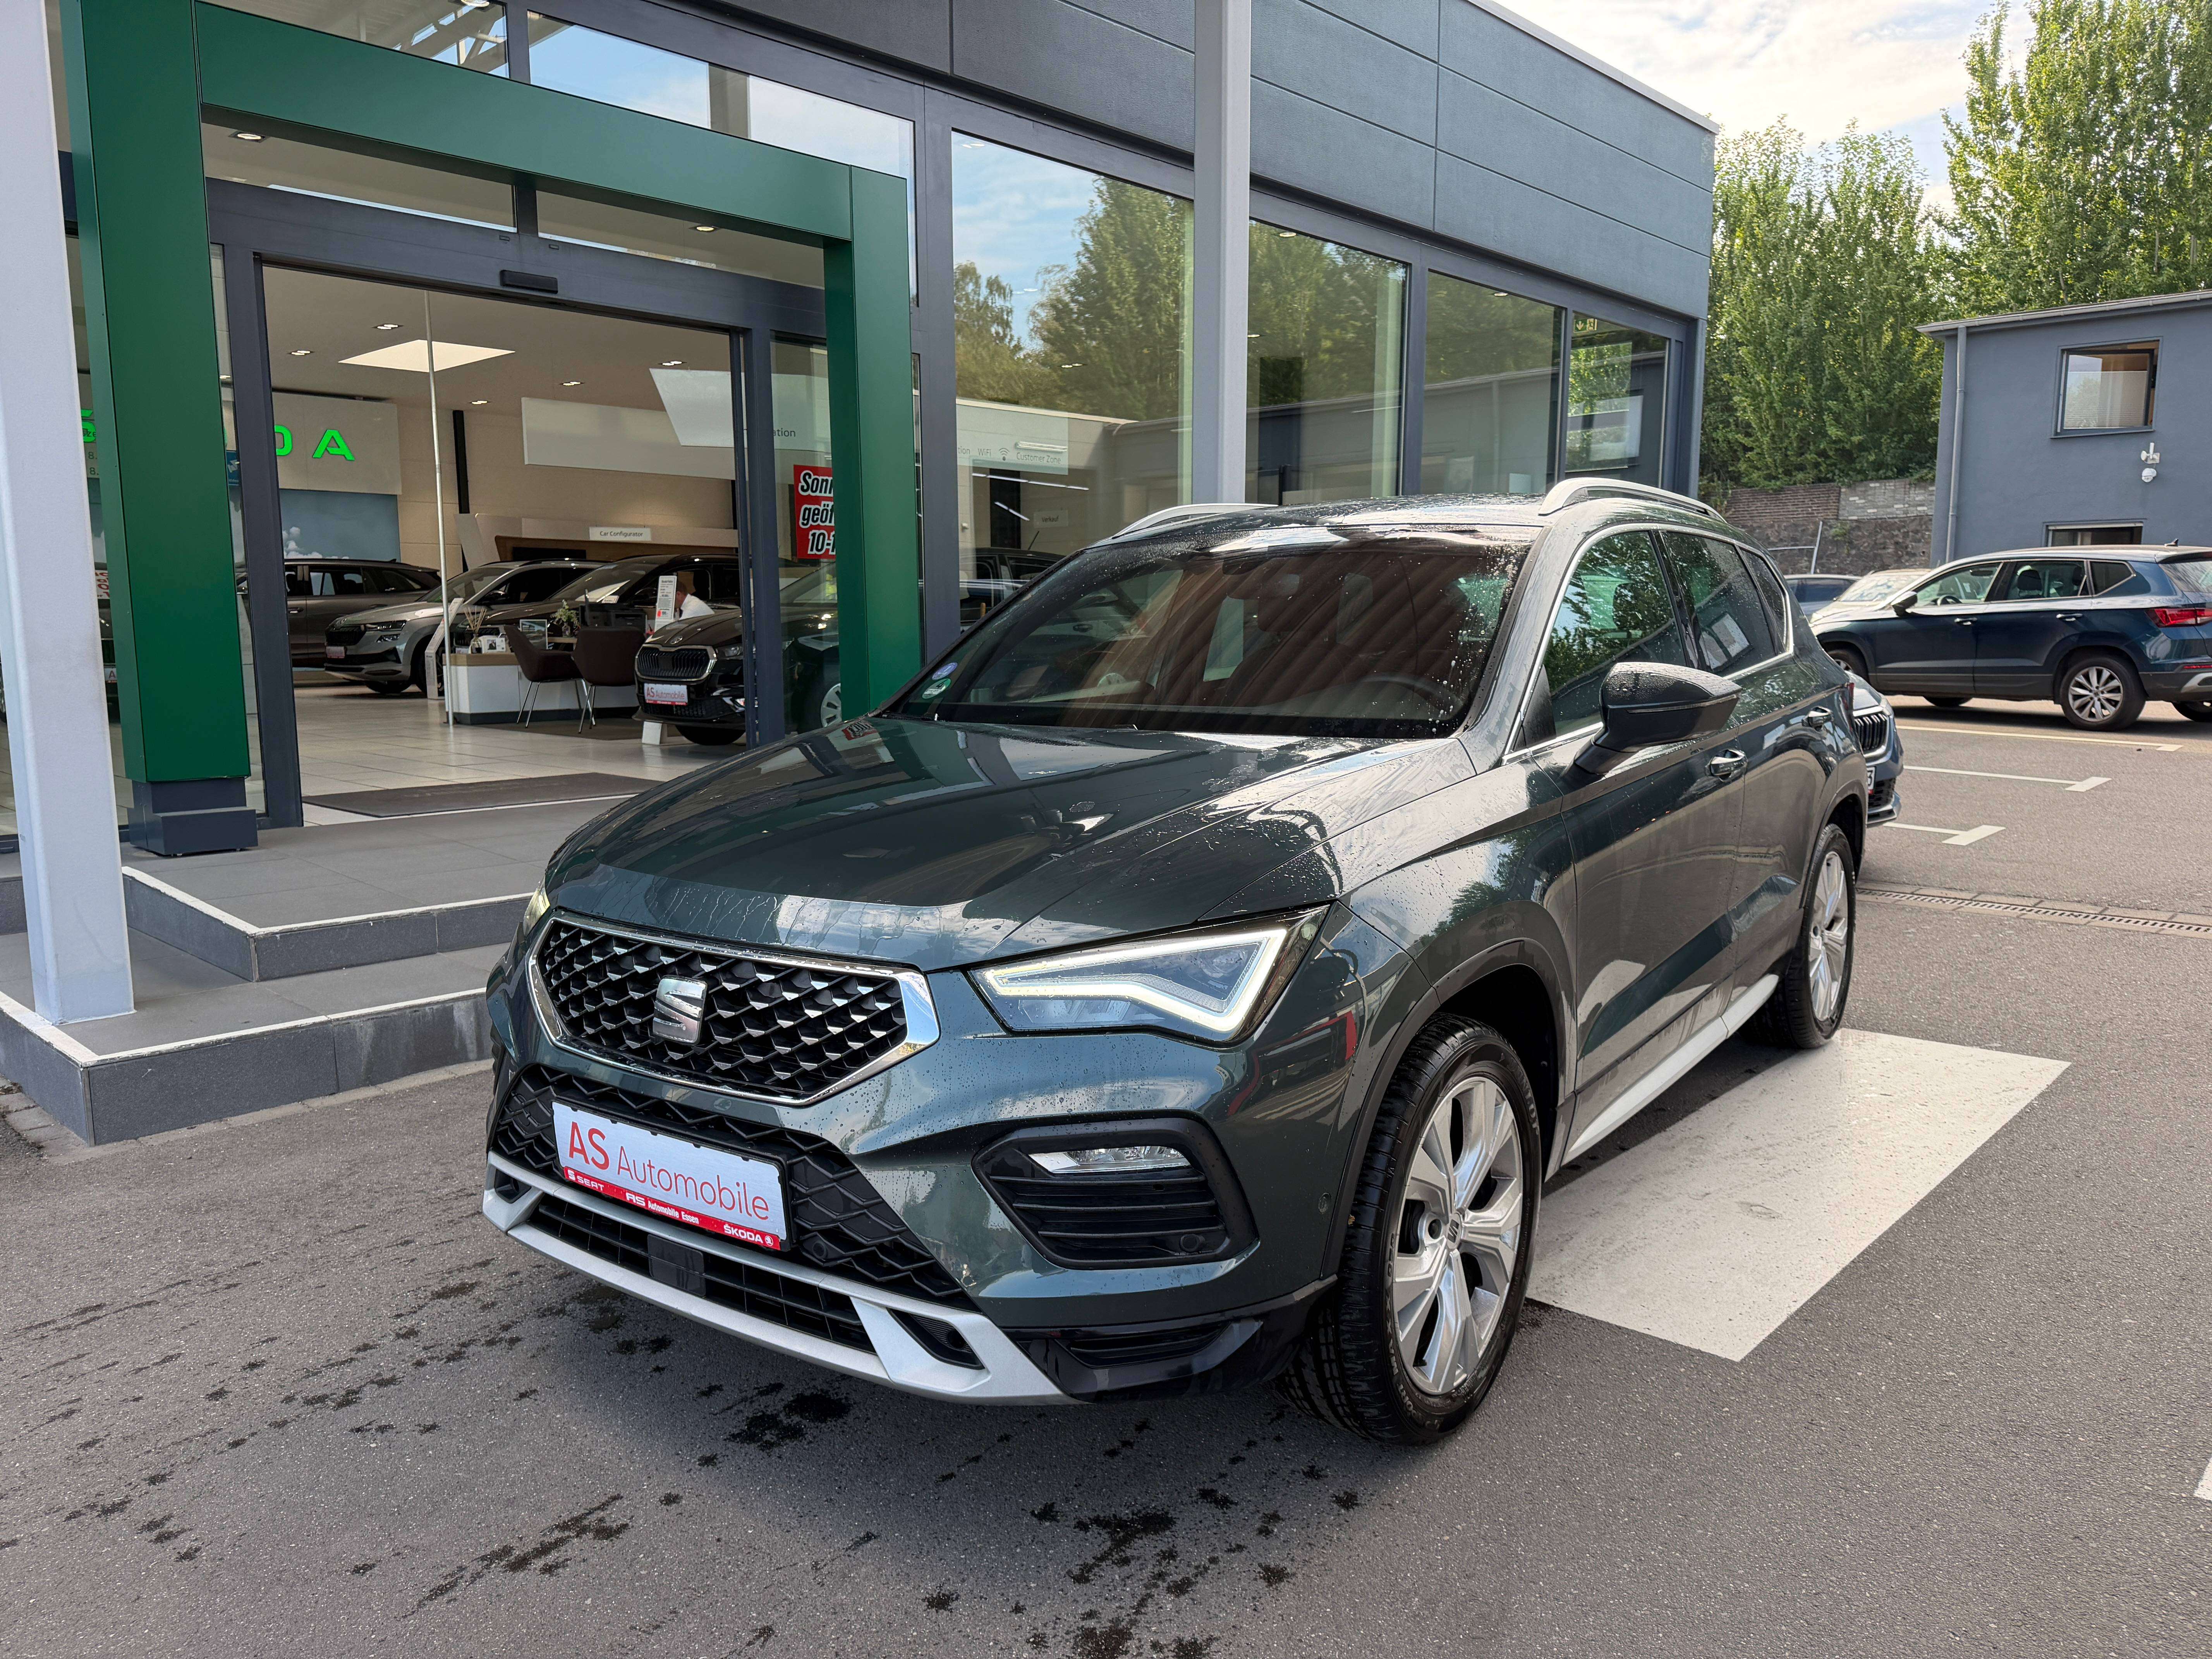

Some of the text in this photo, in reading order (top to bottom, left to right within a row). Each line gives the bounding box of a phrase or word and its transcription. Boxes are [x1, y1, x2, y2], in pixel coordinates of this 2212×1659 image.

[978, 448, 991, 457] WiFi
[1017, 452, 1045, 462] Customer
[1046, 455, 1061, 464] Zone
[936, 679, 948, 689] 4
[647, 687, 655, 698] AS
[569, 1121, 769, 1221] AS Automobile
[577, 1175, 605, 1191] SEAT
[625, 1192, 764, 1244] AS Automobile Essen ŠKODA
